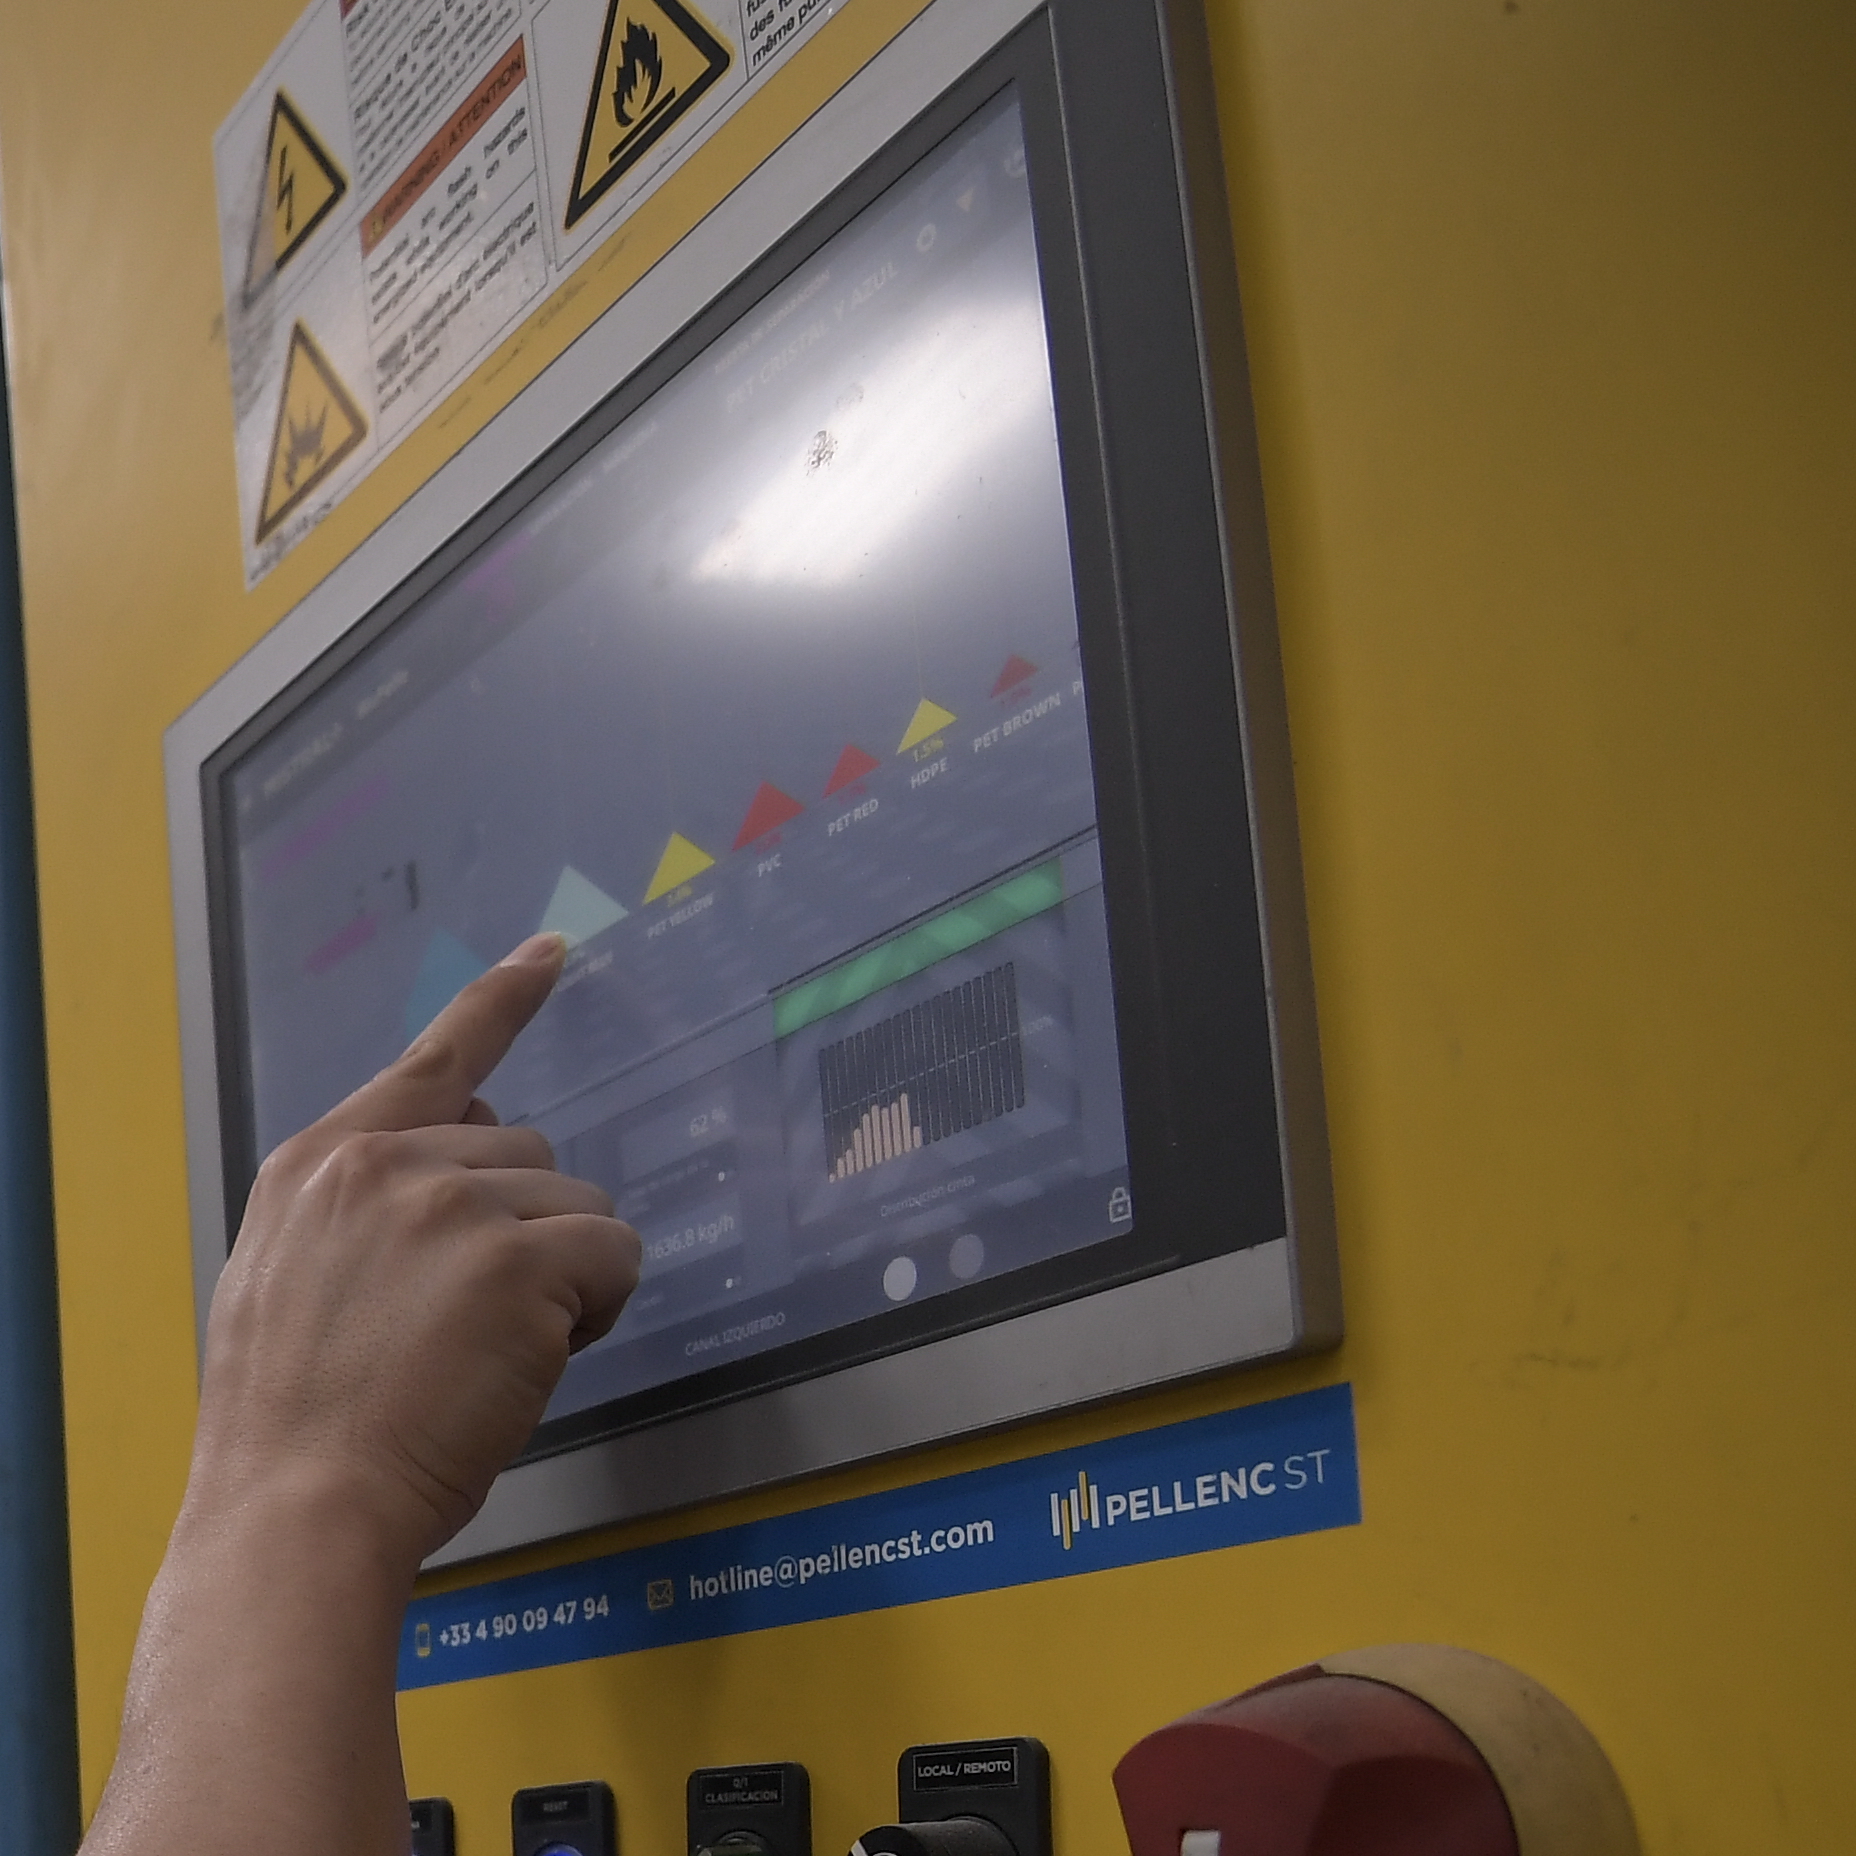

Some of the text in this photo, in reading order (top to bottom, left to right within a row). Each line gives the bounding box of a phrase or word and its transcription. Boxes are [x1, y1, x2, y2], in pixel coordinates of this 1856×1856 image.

[749, 9, 775, 41] des
[972, 731, 1000, 753] PET
[1002, 692, 1062, 738] BROWN
[910, 757, 949, 789] HDPE
[827, 798, 880, 837] PET RED
[758, 853, 783, 878] PVC
[1104, 1448, 1332, 1527] PELLENC ST
[689, 1518, 996, 1601] hotline@pellencst.com
[439, 1594, 610, 1647] +33 4 90 09 47 94
[917, 1764, 955, 1778] LOCAL
[963, 1760, 1012, 1774] REMOTO
